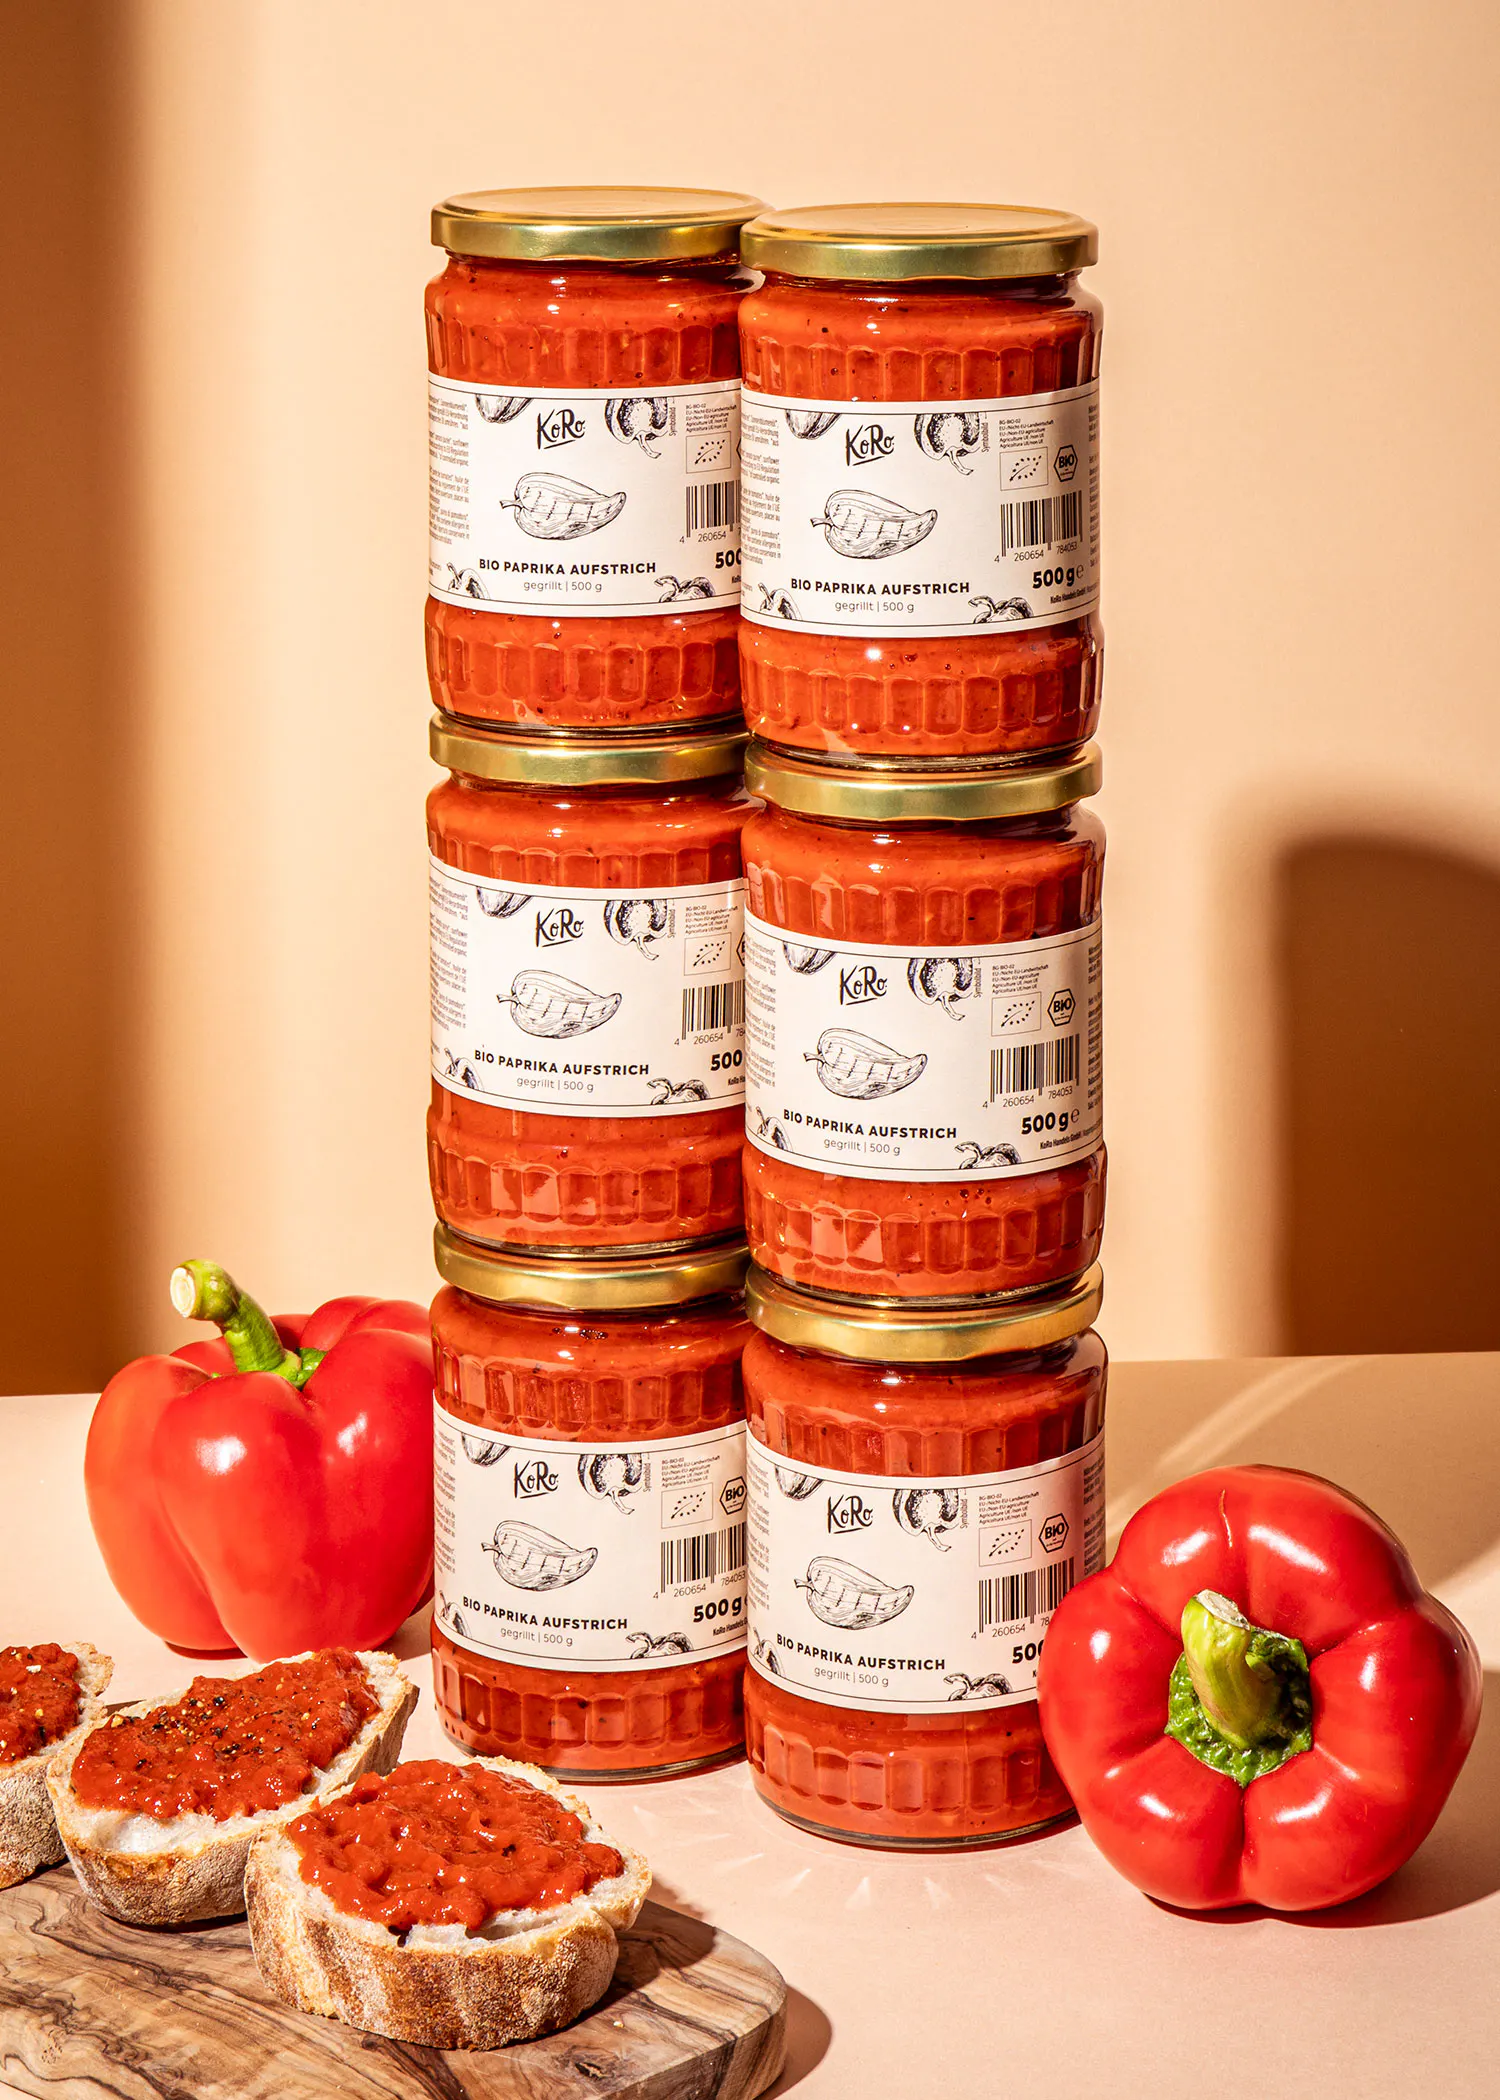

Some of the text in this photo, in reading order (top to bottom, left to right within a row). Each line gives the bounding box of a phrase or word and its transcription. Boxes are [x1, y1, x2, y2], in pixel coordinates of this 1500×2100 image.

[537, 409, 585, 449] KoRo
[846, 425, 894, 466] KoRo
[698, 531, 726, 542] 260654
[480, 559, 655, 574] BIO PAPRIKA AUFSTRICH
[994, 555, 1000, 563] 4
[1014, 550, 1044, 562] 260654
[524, 582, 602, 592] gegrillt 500 g
[792, 578, 969, 595] BIO PAPRIKA AUFSTRICH
[835, 602, 914, 613] gegrillt 500 g
[536, 909, 584, 947] KoRo
[840, 965, 887, 1005] KoRo
[694, 1033, 723, 1045] 260654
[475, 1050, 648, 1075] BIO PAPRIKA AUFSTRICH
[710, 1049, 742, 1071] 500
[517, 1078, 593, 1093] gegrillt 500 g
[982, 1101, 988, 1109] 4
[1003, 1095, 1034, 1107] 260654
[784, 1109, 956, 1138] BIO PAPRIKA AUFSTRICH
[824, 1139, 900, 1156] gegrillt 500 g
[514, 1461, 558, 1499] KoRo
[828, 1495, 873, 1534] KoRo
[674, 1584, 706, 1597] 260654
[463, 1596, 627, 1629] BIO PAPRIKA AUFSTRICH
[500, 1627, 573, 1647] gegrillt 500 g
[992, 1623, 1026, 1638] 260654
[777, 1634, 944, 1670] BIO PAPRIKA AUFSTRICH
[814, 1666, 888, 1687] gegrillt 500 g
